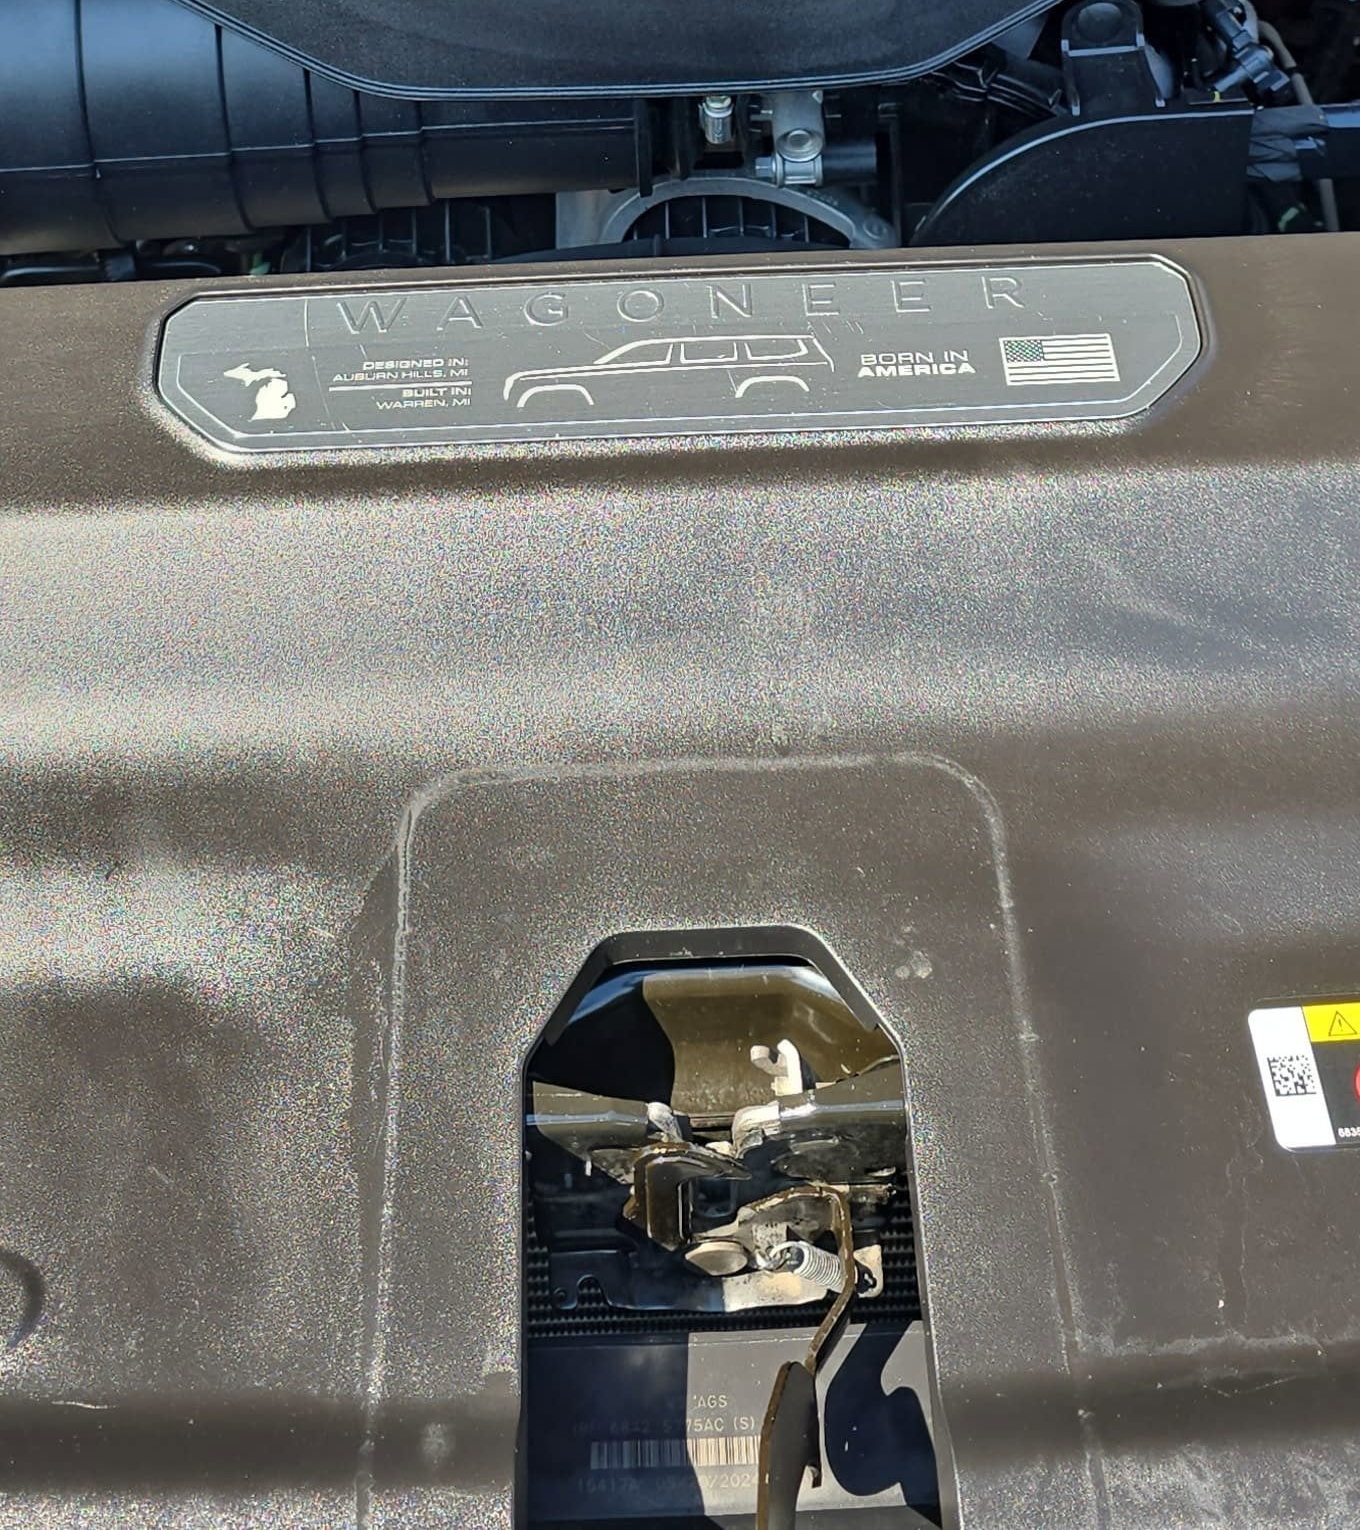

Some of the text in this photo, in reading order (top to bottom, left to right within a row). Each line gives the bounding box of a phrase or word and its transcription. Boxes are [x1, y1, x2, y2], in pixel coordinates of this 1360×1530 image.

[337, 276, 1026, 335] WAGONEER
[362, 357, 469, 371] DESIGNED IN:
[860, 350, 969, 366] BORN IN
[332, 371, 399, 382] AUBURN
[449, 368, 469, 377] MI
[857, 362, 977, 378] AMERICA
[402, 387, 449, 398] BUILT
[451, 398, 471, 407] MI
[733, 1415, 756, 1431] (S)
